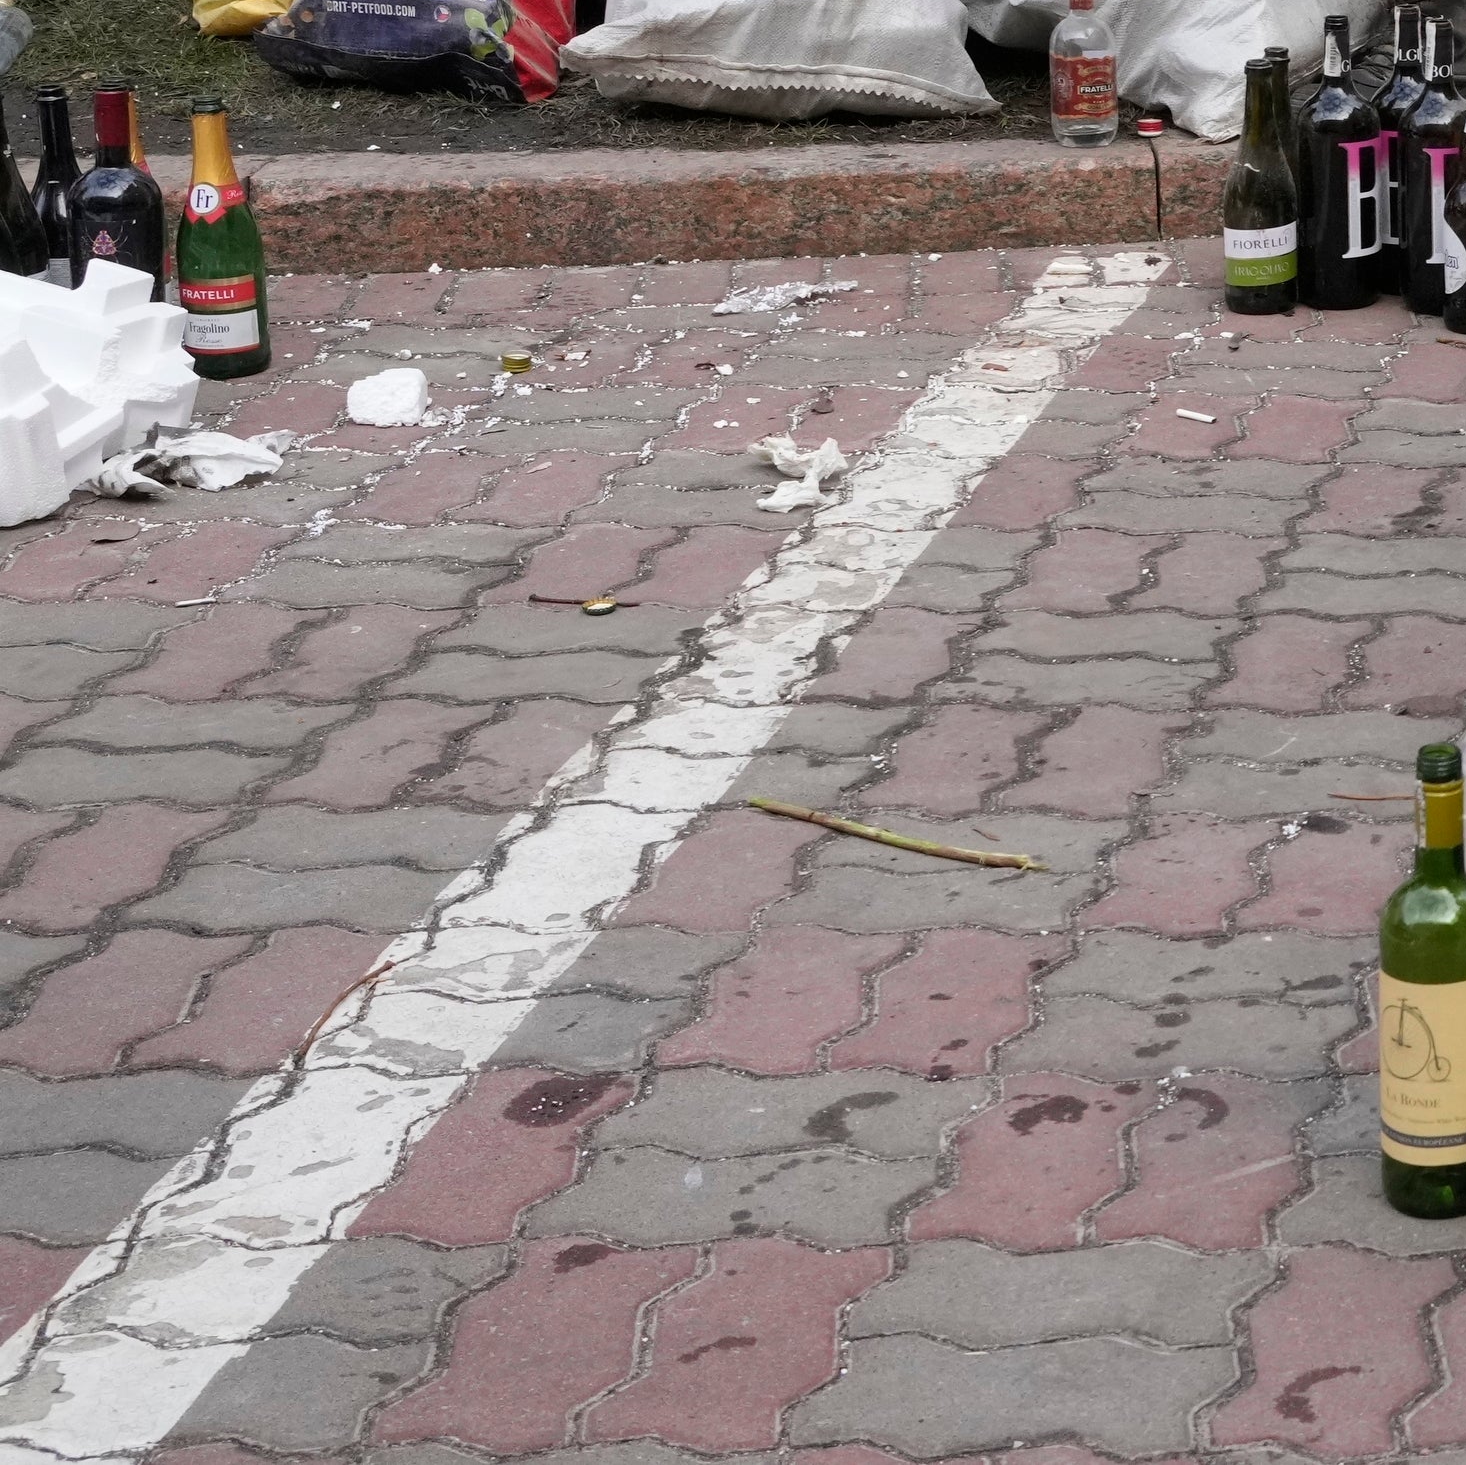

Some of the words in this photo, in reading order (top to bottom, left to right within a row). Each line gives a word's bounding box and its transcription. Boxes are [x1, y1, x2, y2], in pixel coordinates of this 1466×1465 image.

[195, 188, 214, 209] Fr
[1233, 236, 1289, 251] FIORELLI
[182, 288, 235, 300] FRATELLI
